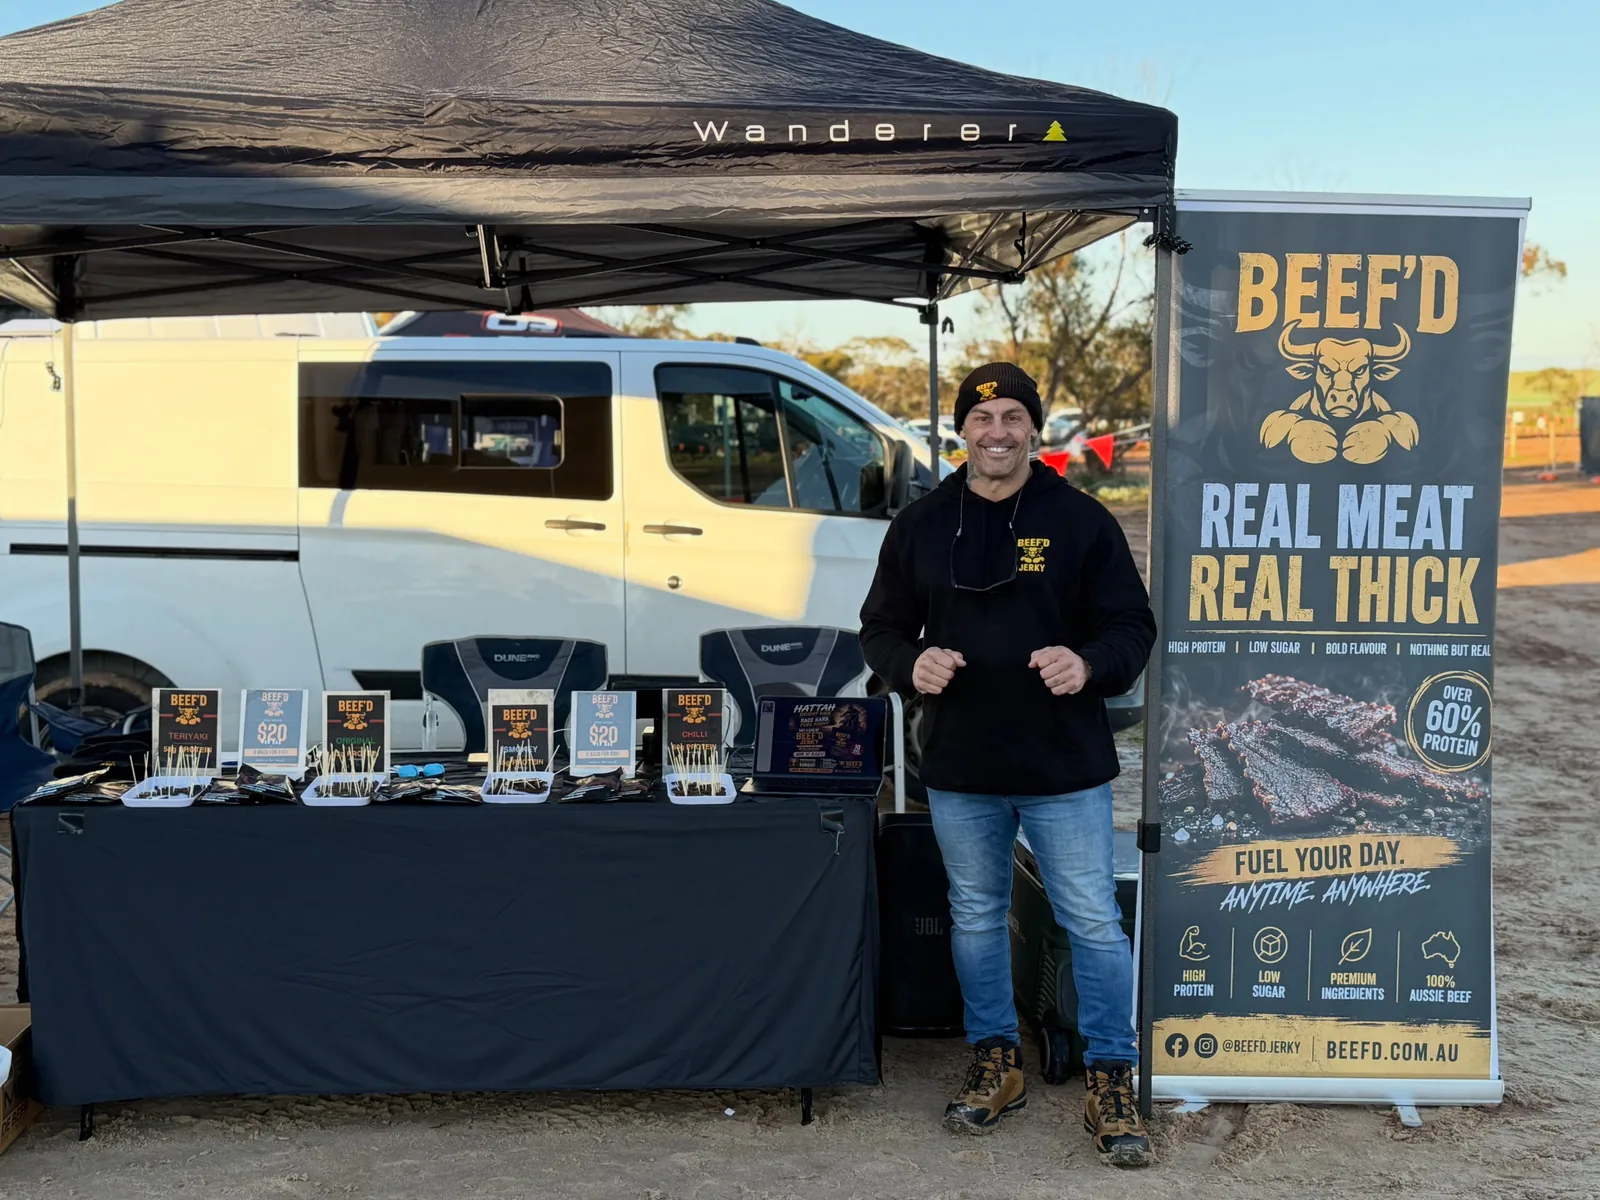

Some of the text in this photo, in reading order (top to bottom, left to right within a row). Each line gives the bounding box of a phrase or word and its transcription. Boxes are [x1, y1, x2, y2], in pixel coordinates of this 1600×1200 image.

[692, 118, 1017, 142] Wanderer
[1235, 252, 1460, 335] BEEF'D
[1200, 482, 1474, 550] REAL MEAT
[1017, 538, 1050, 547] BEEF'D
[1018, 564, 1045, 573] JERKY
[1189, 555, 1481, 624] REAL THICK
[761, 643, 791, 652] DUNE
[1168, 640, 1226, 654] HIGH PROTEIN
[1249, 641, 1300, 654] LOW SUGAR
[1325, 642, 1387, 655] BOLD FLAVOUR
[1409, 643, 1491, 657] NOTHING BUT REAL
[494, 653, 527, 662] DUNE
[170, 693, 208, 706] BEEF'D
[678, 694, 712, 706] BEEF'D
[1443, 685, 1473, 702] OVER
[338, 699, 374, 712] BEEF'D
[793, 703, 836, 714] HATTAH
[503, 709, 537, 721] BEEF'D
[1425, 700, 1483, 738] 60%
[168, 732, 208, 740] TERIYAKI
[257, 721, 288, 743] $20
[589, 723, 619, 745] $20
[796, 731, 824, 740] BEEF'D
[336, 737, 376, 745] ORIGINAL
[1422, 732, 1479, 757] PROTEIN
[1235, 840, 1404, 876] FUEL YOUR DAY.
[1219, 868, 1431, 914] ANYTIME. ANYWHERE.
[914, 916, 944, 936] JBL
[1182, 969, 1206, 982] HIGH
[1258, 970, 1281, 983] LOW
[1330, 972, 1377, 986] PREMIUM
[1426, 974, 1456, 988] 100%
[1173, 984, 1214, 997] PROTEIN
[1252, 984, 1286, 998] SUGAR
[1321, 987, 1385, 1001] INGREDIENTS
[1409, 989, 1472, 1003] AUSSIE BEEF
[1222, 1039, 1301, 1054] @BEEFD.JERKY
[1326, 1040, 1459, 1062] BEEFD.COM.AU
